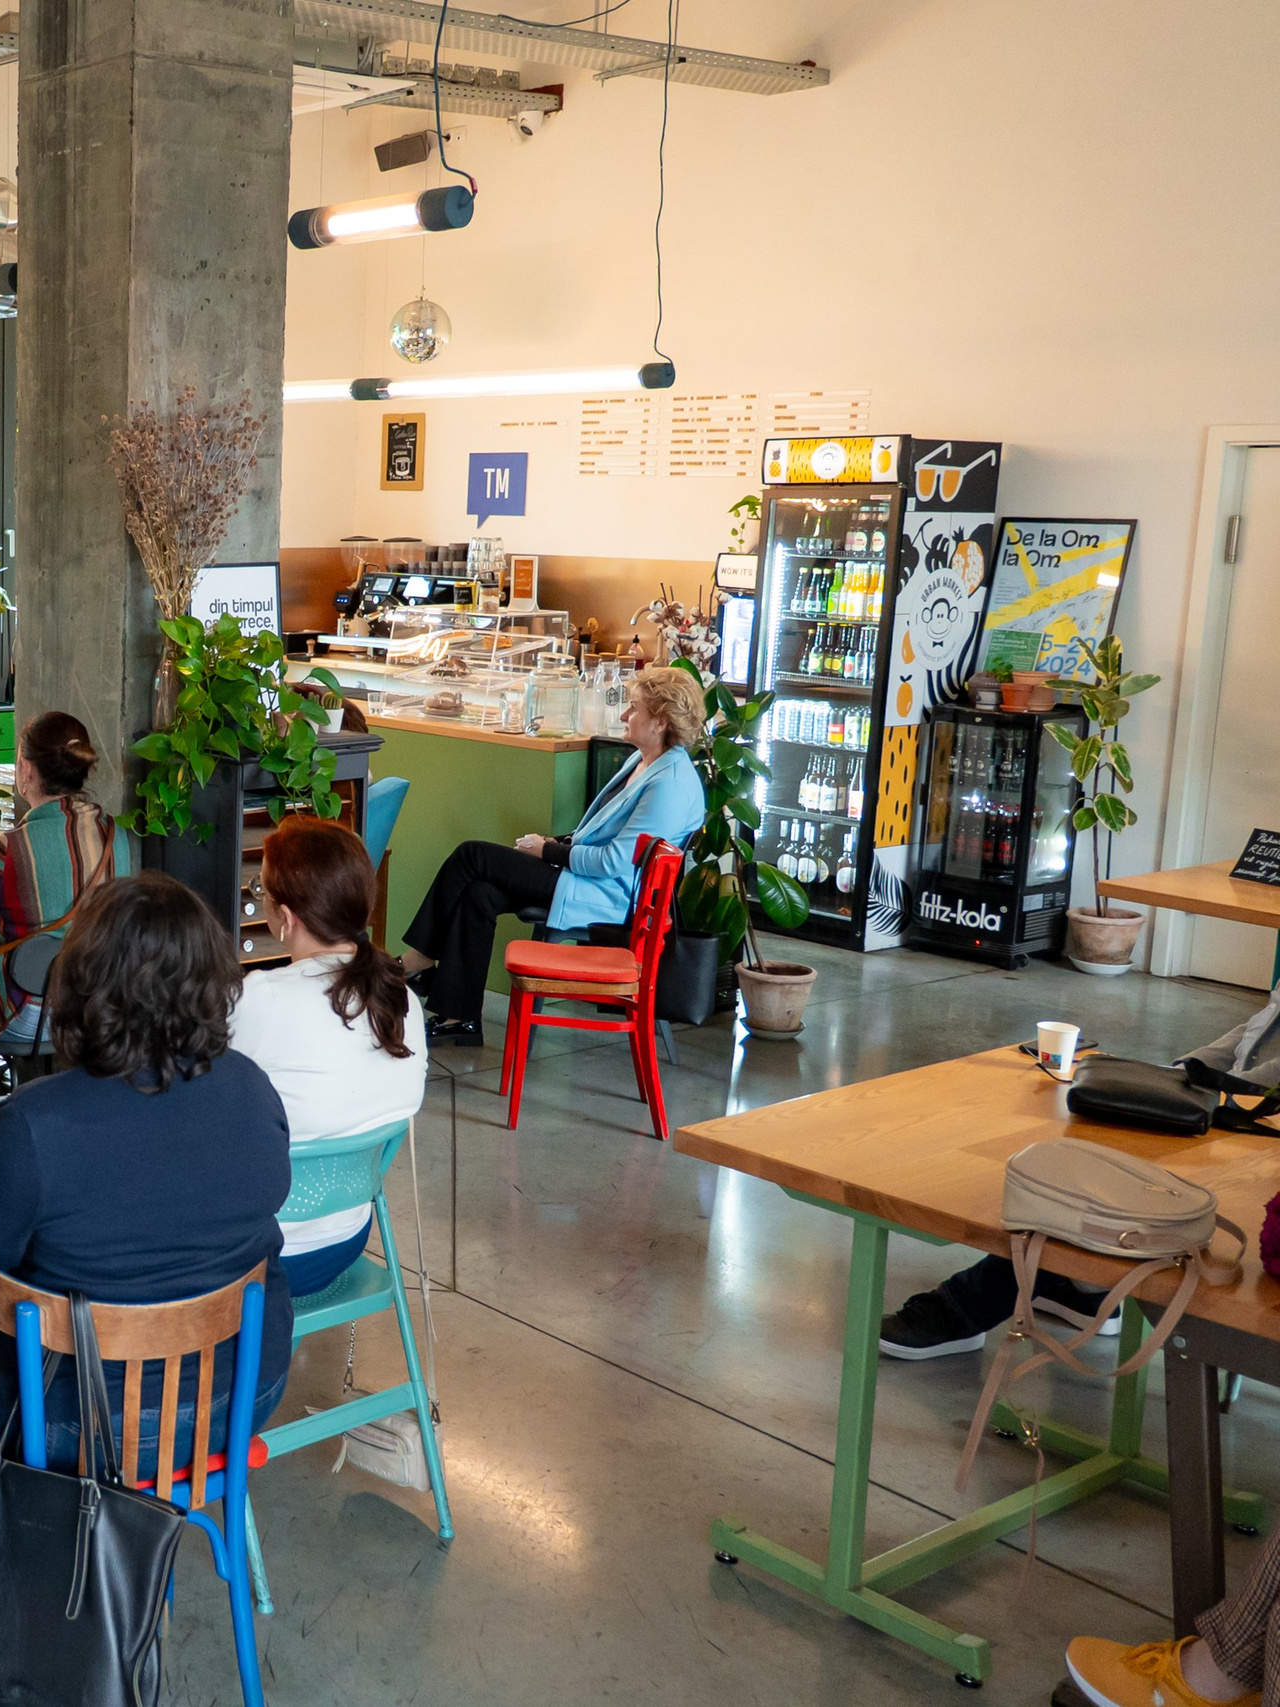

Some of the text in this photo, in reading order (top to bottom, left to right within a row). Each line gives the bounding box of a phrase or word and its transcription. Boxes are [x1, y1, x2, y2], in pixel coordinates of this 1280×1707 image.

[483, 467, 510, 499] TM
[1006, 528, 1100, 548] De la Om
[1002, 549, 1062, 568] la Om
[920, 576, 963, 602] URBAN MONKEY
[209, 597, 274, 616] din timpul
[1036, 655, 1091, 676] 2024
[1257, 832, 1280, 845] Paha
